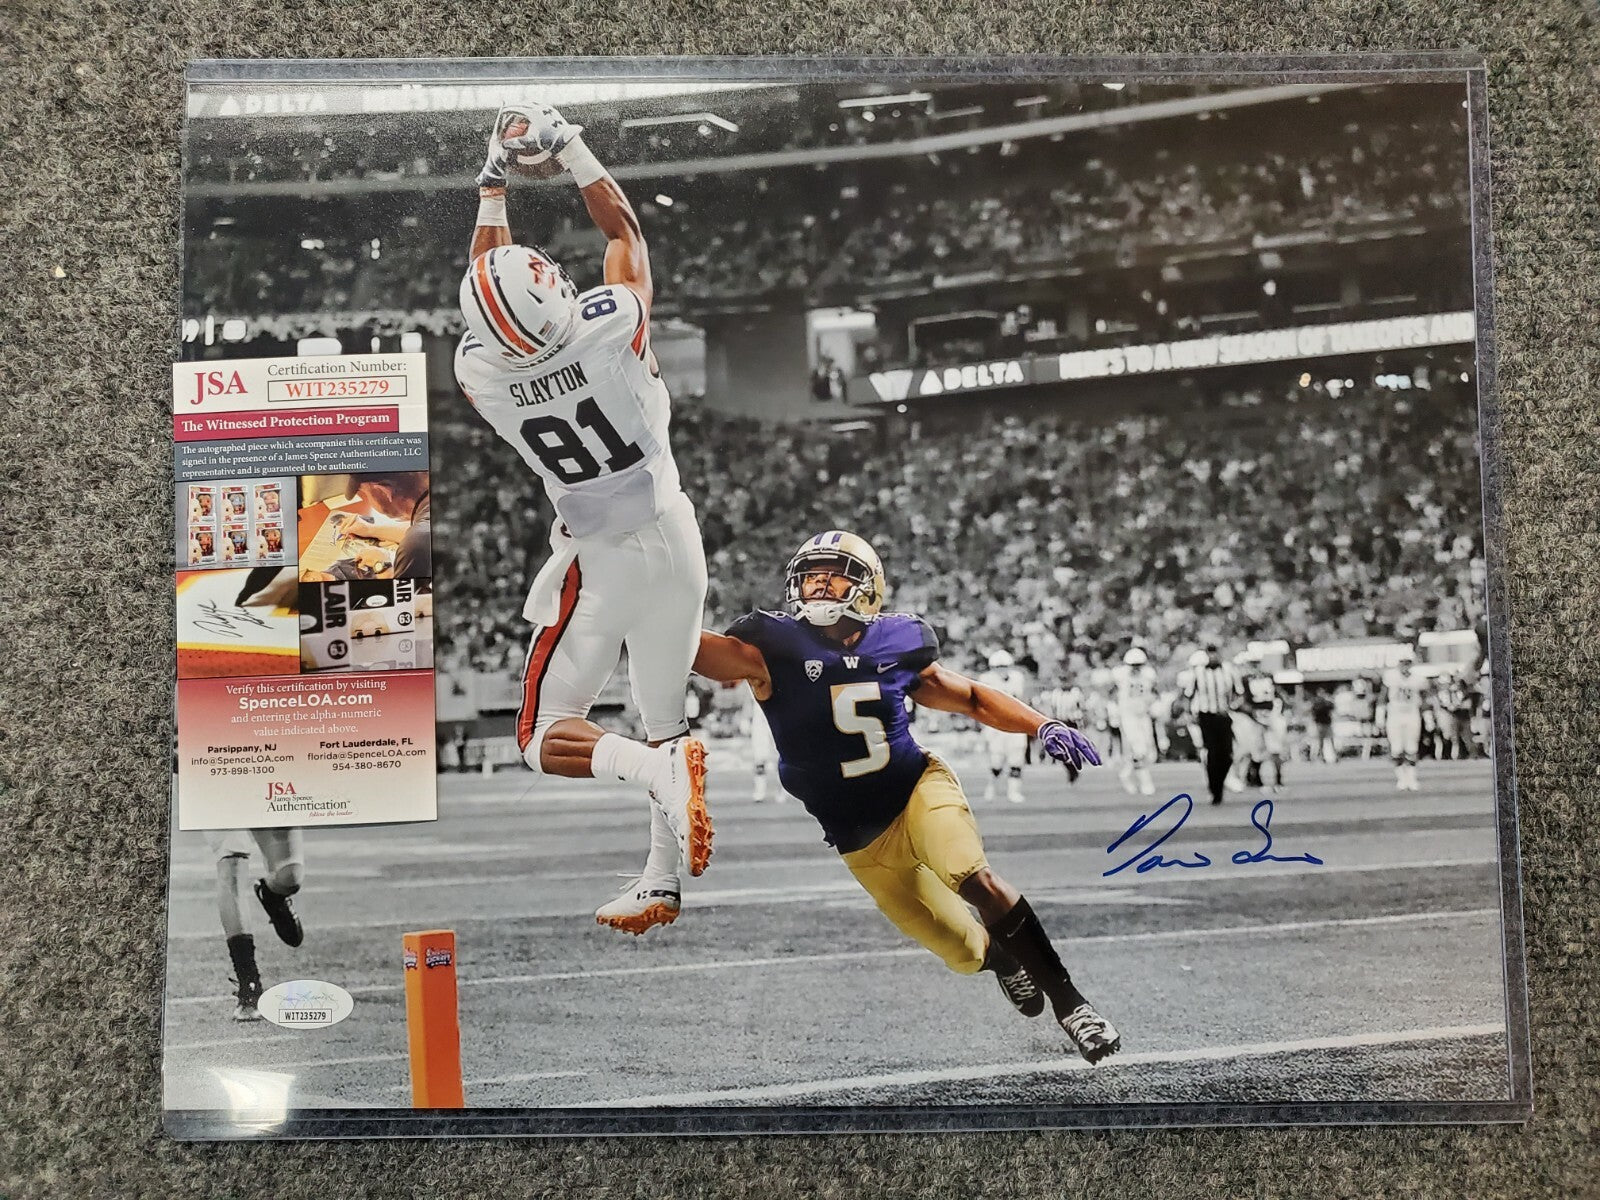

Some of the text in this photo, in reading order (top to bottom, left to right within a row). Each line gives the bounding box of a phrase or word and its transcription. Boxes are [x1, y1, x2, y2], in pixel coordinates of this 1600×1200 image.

[267, 360, 407, 377] Certification Number:
[943, 360, 1025, 391] DELTA
[190, 370, 248, 405] JSA
[285, 380, 389, 398] WIT235279
[509, 361, 589, 408] SLAYTON
[182, 413, 390, 432] The Witnessed Protection Program
[182, 446, 197, 455] The
[198, 443, 246, 455] autographed
[247, 443, 268, 453] piece
[270, 440, 294, 450] which
[296, 439, 347, 449] accompanies
[348, 437, 364, 446] this
[365, 436, 404, 446] certificate
[519, 396, 646, 485] 81
[182, 456, 207, 467] signed
[208, 456, 217, 465] in
[218, 455, 231, 464] the
[232, 455, 267, 465] presence
[268, 453, 278, 461] of
[284, 452, 308, 461] James
[309, 451, 338, 461] Spence
[339, 448, 402, 458] Authentication,
[404, 447, 422, 456] LLC
[182, 467, 236, 479] representative
[236, 466, 252, 475] and
[253, 466, 261, 474] is
[261, 463, 306, 475] guaranteed
[317, 463, 327, 471] be
[328, 461, 369, 470] authentic.
[842, 656, 860, 669] W
[226, 679, 387, 696] Verify this certification by visiting
[239, 693, 373, 711] SpenceLOA.com
[231, 708, 382, 724] and entering the alpha-numeric
[253, 723, 359, 736] value indicated above.
[829, 681, 890, 779] 5
[207, 743, 277, 754] Parsippany, NJ
[319, 737, 414, 749] Fort Lauderdale, FL
[191, 754, 294, 766] info@SpenceLOA.com
[307, 748, 427, 761] florida@SpenceLOA.com
[210, 765, 275, 776] 973-898-1300
[332, 760, 402, 771] 954-380-8670
[265, 781, 297, 800] JSA
[284, 1011, 327, 1021] WIT235279
